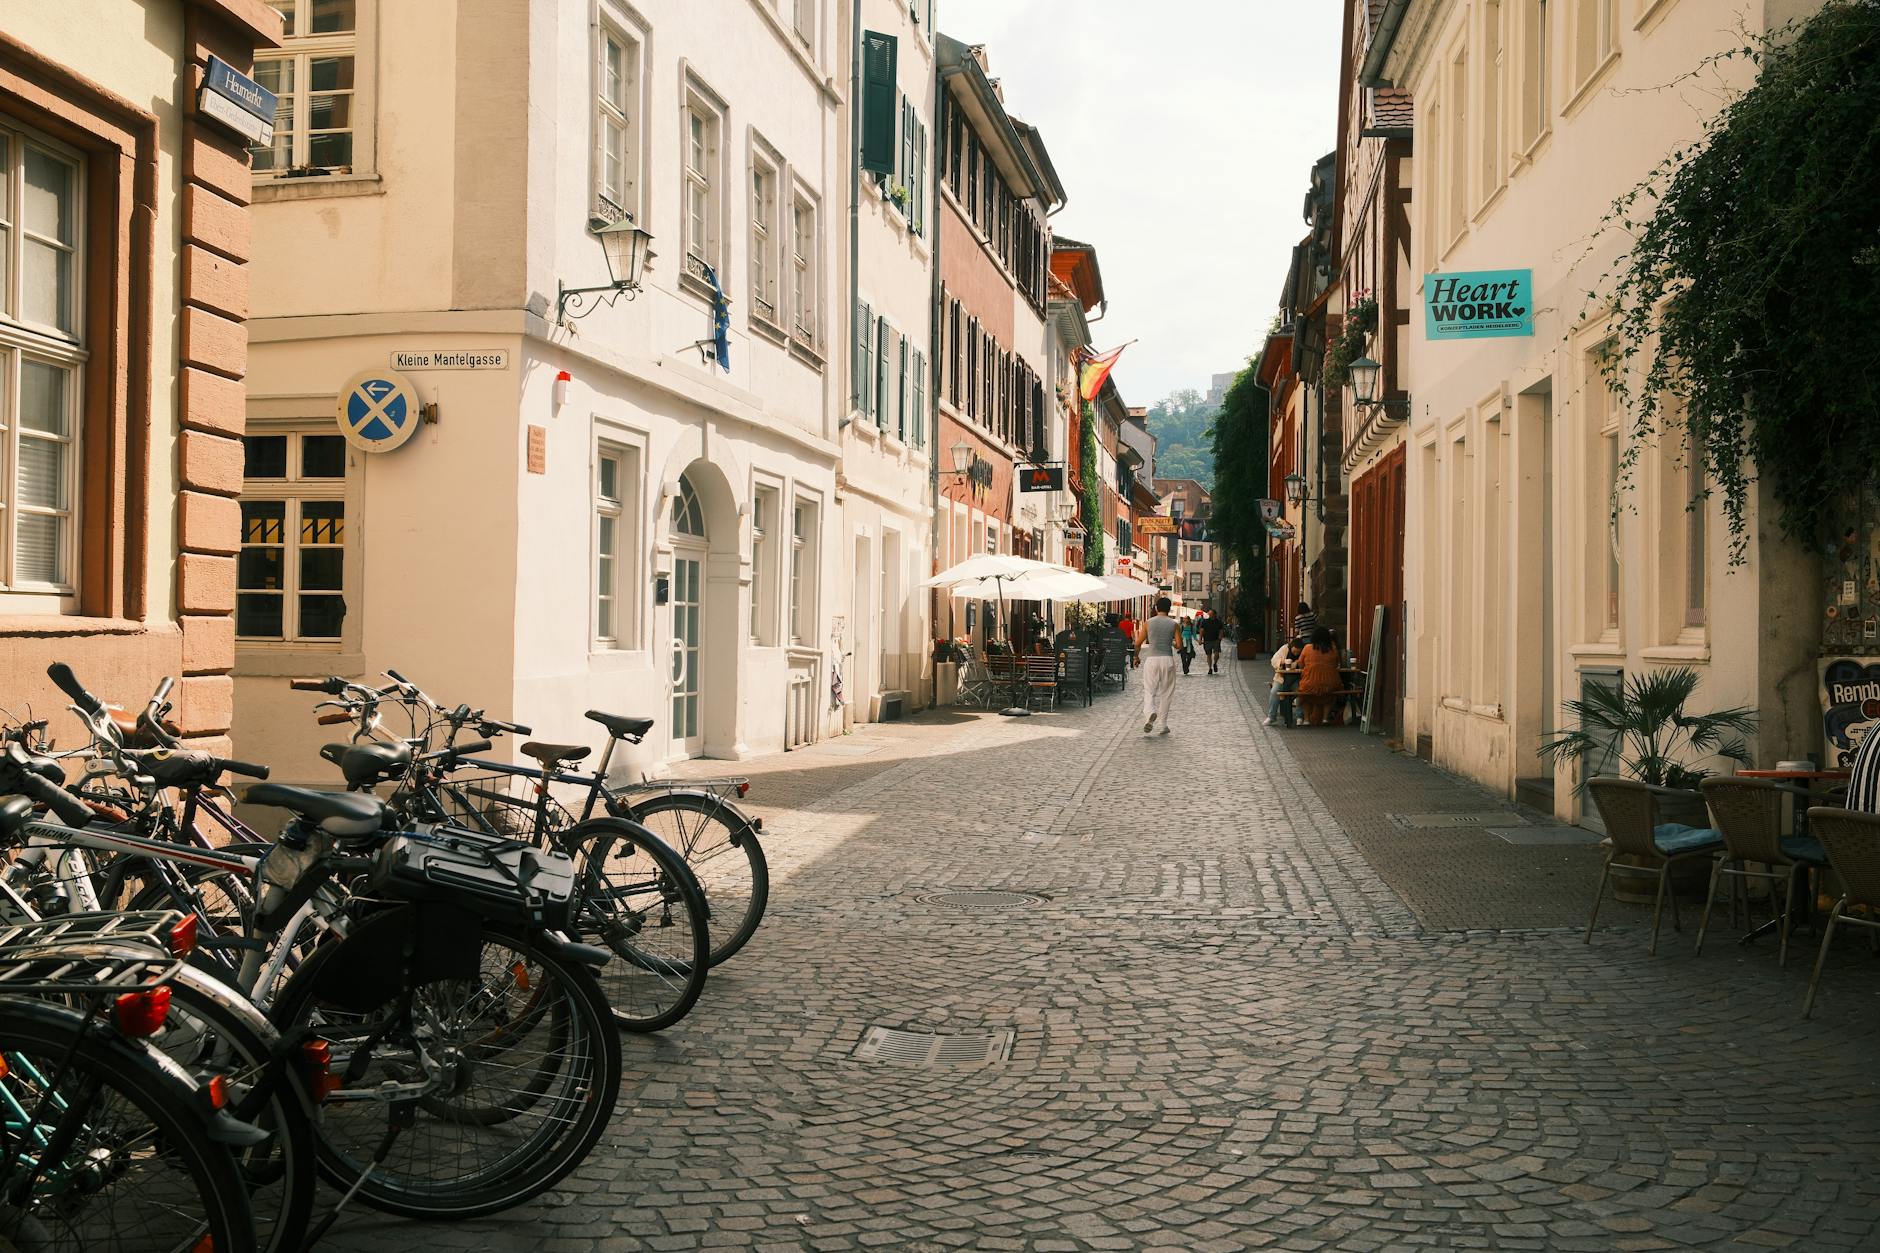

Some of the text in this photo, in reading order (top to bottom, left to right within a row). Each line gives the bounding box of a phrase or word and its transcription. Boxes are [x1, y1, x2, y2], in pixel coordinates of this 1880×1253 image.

[225, 71, 263, 108] Heumarkt
[1429, 278, 1520, 303] Heart
[1432, 302, 1513, 321] WORK
[397, 352, 501, 368] Kleine Mantelgasse
[25, 826, 74, 841] MACINA
[67, 856, 94, 911] PEGA
